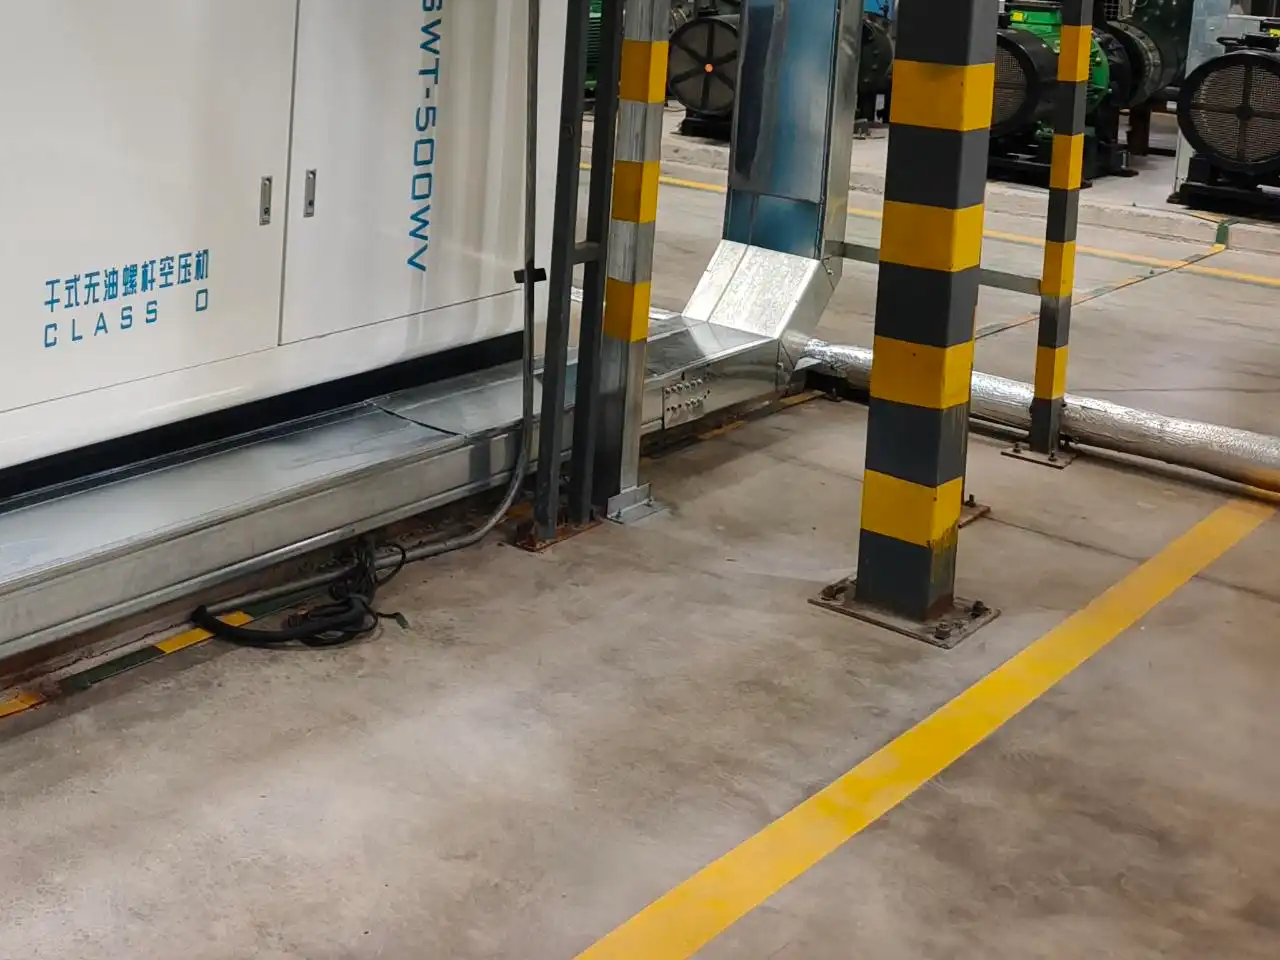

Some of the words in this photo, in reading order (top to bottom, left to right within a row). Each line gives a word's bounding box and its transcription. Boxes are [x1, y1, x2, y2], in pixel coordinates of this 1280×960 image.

[44, 249, 209, 313] 干式无油螺杆空压机
[44, 300, 158, 348] CLASS
